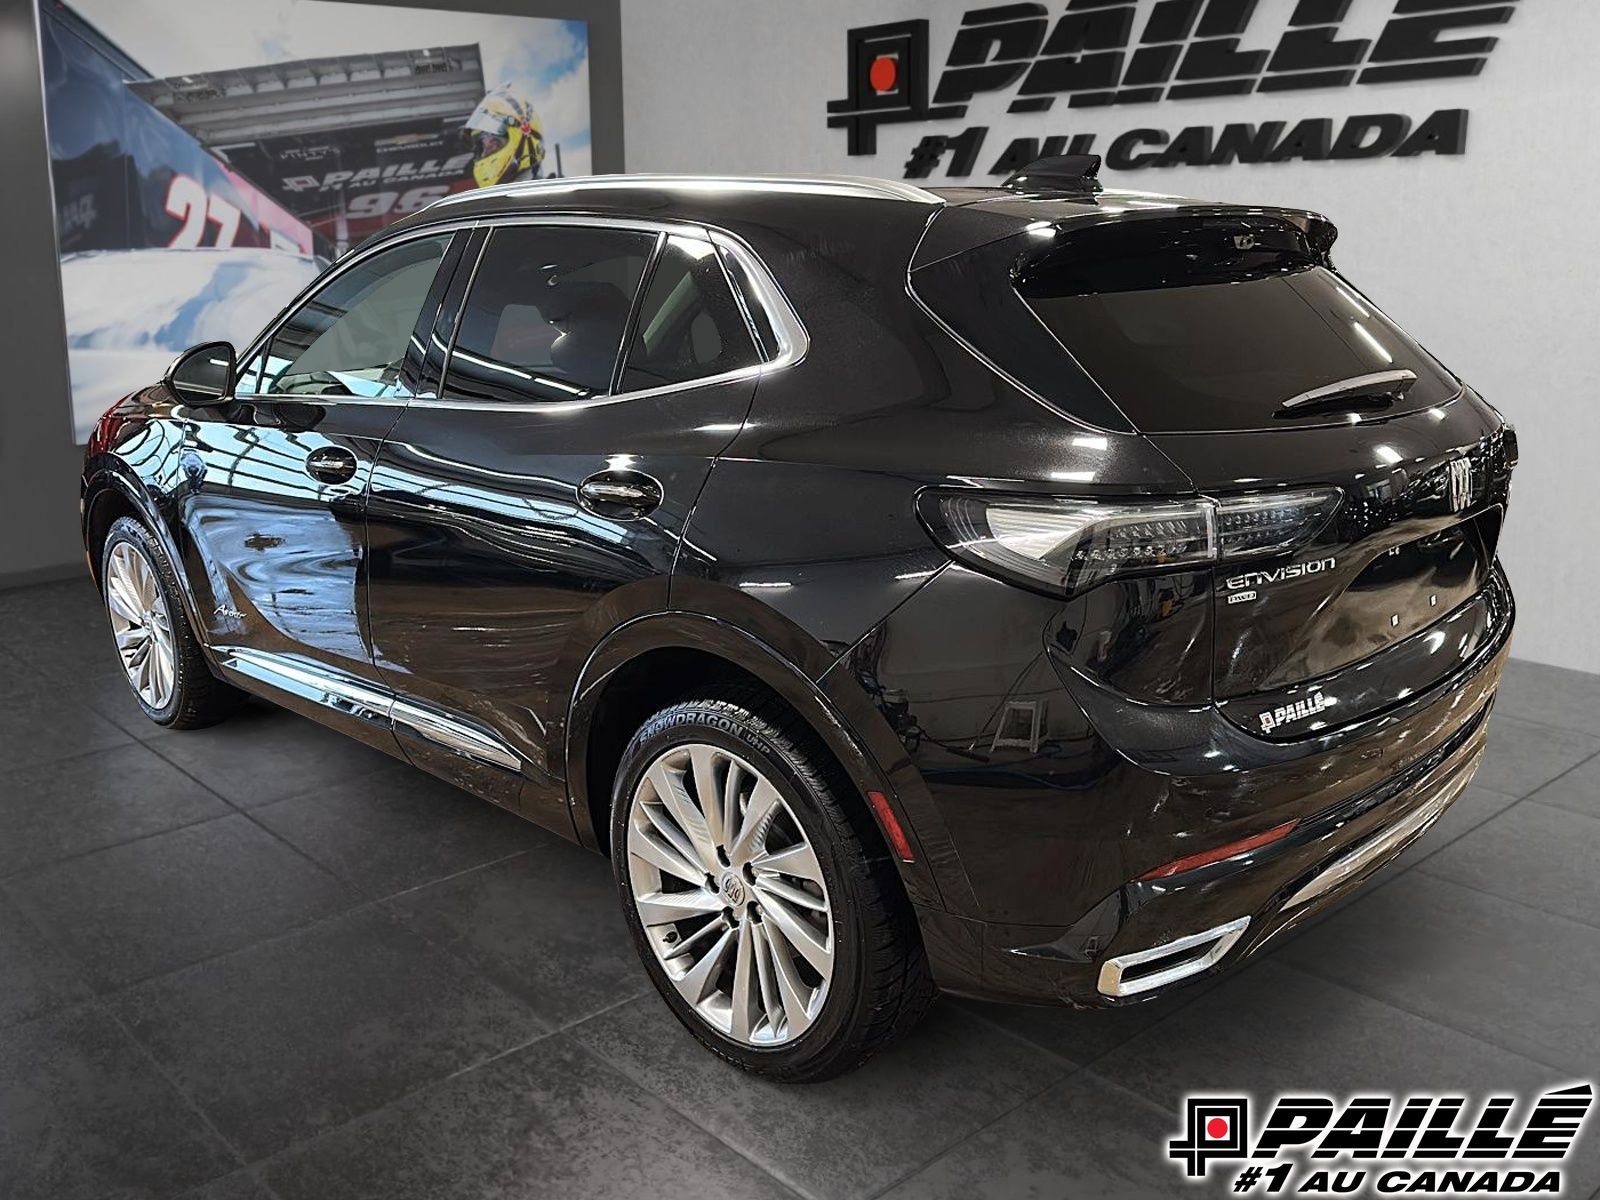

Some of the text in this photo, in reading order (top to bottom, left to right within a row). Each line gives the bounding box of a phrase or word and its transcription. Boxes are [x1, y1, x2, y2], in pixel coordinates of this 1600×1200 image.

[903, 126, 990, 179] #1
[1105, 109, 1469, 170] CANADA
[346, 185, 450, 220] 96
[639, 712, 772, 754] SNOWDRAGON UHP
